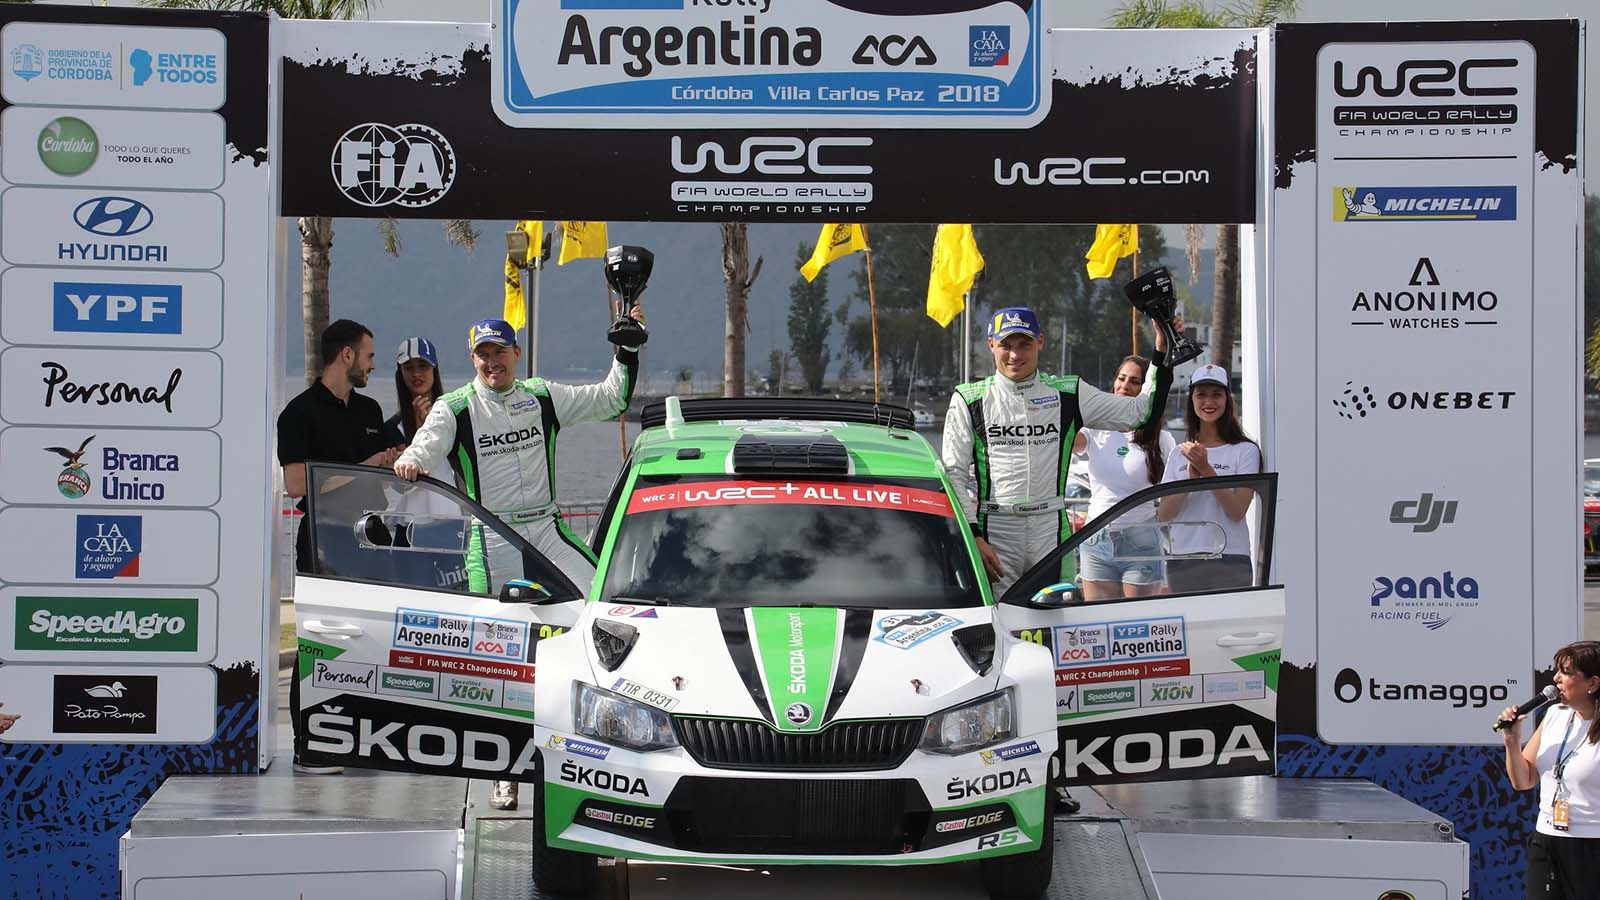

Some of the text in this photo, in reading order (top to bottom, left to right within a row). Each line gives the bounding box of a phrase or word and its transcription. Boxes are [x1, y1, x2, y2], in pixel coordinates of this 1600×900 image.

[981, 30, 998, 40] LA
[48, 50, 112, 59] GOBIERNO DE LA
[557, 14, 822, 78] Argentina
[852, 34, 937, 66] ACA
[973, 40, 1005, 52] CAJA
[48, 58, 112, 68] PROVINCIA DE
[158, 54, 216, 68] ENTRE
[48, 66, 113, 80] CÓRDOBA
[157, 69, 217, 84] TODOS
[1334, 58, 1518, 98] WRC
[671, 85, 1000, 102] Córdoba Villa Carlos Paz 2018
[1339, 110, 1512, 120] FIA WORLD RALLY
[1339, 127, 1512, 137] CHAMPIONSHIP
[104, 145, 128, 153] TODO
[129, 146, 140, 154] LO
[142, 146, 158, 154] QUE
[671, 136, 874, 174] WRC
[118, 155, 174, 164] TODO EL AÑO
[994, 157, 1209, 186] WRC.com
[677, 187, 867, 197] FIA WORLD RALLY
[677, 204, 867, 214] CHAMPIONSHIP
[1384, 197, 1502, 211] MICHELIN
[58, 243, 168, 262] HYUNDAI
[65, 294, 169, 322] YPF
[1351, 291, 1498, 311] ANONIMO
[1390, 318, 1460, 329] WATCHES
[41, 361, 182, 413] Personal
[1387, 391, 1516, 410] ONEBET
[478, 426, 542, 448] ŠKODA
[988, 424, 1059, 438] ŠKODA
[103, 447, 180, 472] Branca
[102, 472, 165, 501] Único
[642, 494, 666, 503] WRC
[803, 487, 846, 501] ALL
[852, 489, 902, 505] LIVE
[97, 523, 124, 538] LA
[83, 537, 134, 556] CAJA
[83, 554, 122, 564] de ahorro
[90, 562, 115, 572] seguro
[1370, 571, 1479, 606] panta
[29, 610, 186, 640] SpeedAgro
[407, 615, 468, 633] YPF Rally
[1370, 612, 1442, 620] RACING FUEL
[397, 626, 470, 648] Argentina
[789, 612, 804, 648] Motorsport
[1118, 624, 1178, 636] YPF Rally
[475, 641, 504, 654] ACA
[1062, 648, 1090, 660] ACA
[1112, 638, 1182, 658] Argentina
[316, 662, 373, 689] Personal
[427, 659, 440, 668] FIA
[442, 661, 458, 670] WRC
[466, 664, 518, 677] Championship
[787, 650, 806, 694] ŠKODA
[1062, 672, 1080, 680] WRC
[1082, 672, 1086, 680] 2
[1088, 668, 1140, 679] Championship
[386, 676, 430, 689] SpeedAgro
[449, 684, 494, 702] XION
[644, 690, 672, 708] 0331
[1150, 685, 1194, 701] XION
[1369, 678, 1508, 708] tamaggo
[64, 704, 146, 725] Pato Pampa
[570, 743, 609, 756] MICHELIN
[1001, 743, 1038, 757] MICHELIN
[1052, 724, 1270, 779] KODA
[560, 759, 650, 797] ŠKODA
[946, 768, 1032, 800] ŠKODA
[613, 813, 656, 829] EDGE
[944, 810, 1004, 830] Castrol EDGE
[978, 830, 1018, 850] R5
